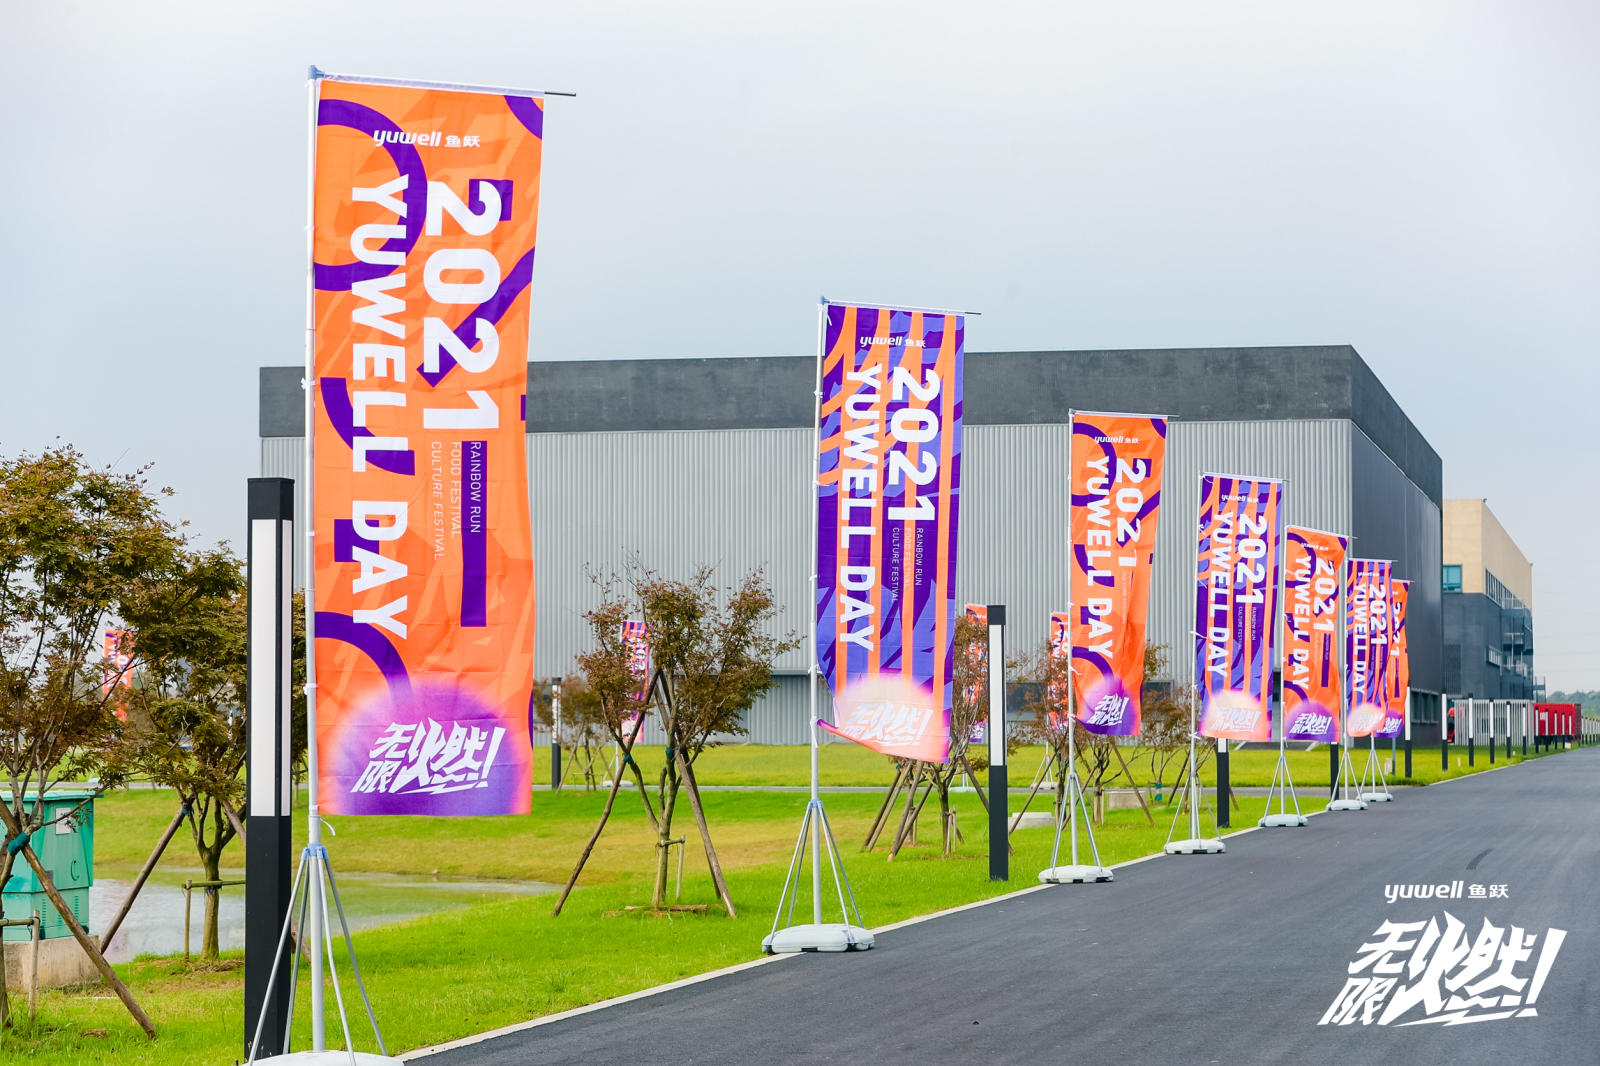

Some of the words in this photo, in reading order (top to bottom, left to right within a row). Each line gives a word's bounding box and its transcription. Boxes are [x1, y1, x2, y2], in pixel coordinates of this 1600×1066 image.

[373, 129, 442, 147] yuwell
[444, 135, 481, 148] 鱼跃
[350, 173, 409, 473] YUWELL
[423, 180, 502, 430] 2021
[860, 336, 903, 348] yuwell
[431, 441, 443, 497] CULTURE
[451, 441, 461, 468] FOOD
[470, 441, 481, 503] RAINBOW
[840, 363, 882, 549] YUWELL
[887, 366, 941, 521] 2021
[433, 500, 444, 561] FESTIVAL
[450, 471, 461, 538] FESTIVAL
[469, 506, 481, 534] RUN
[1086, 455, 1112, 587] YUWELL
[1116, 458, 1147, 567] 2021
[351, 500, 408, 640] DAY
[892, 527, 900, 564] CULTURE
[915, 527, 923, 566] RAINBOW
[1209, 511, 1234, 618] YUWELL
[1235, 513, 1268, 604] 2021
[891, 566, 899, 603] FESTIVAL
[914, 568, 923, 586] RUN
[1293, 555, 1312, 642] YUWELL
[1313, 557, 1336, 631] 2021
[839, 565, 876, 652] DAY
[1087, 597, 1114, 659] DAY
[1354, 582, 1368, 656] YUWELL
[1369, 583, 1388, 645] 2021
[1207, 627, 1230, 678] DAY
[1292, 648, 1310, 690] DAY
[1353, 660, 1368, 695] DAY
